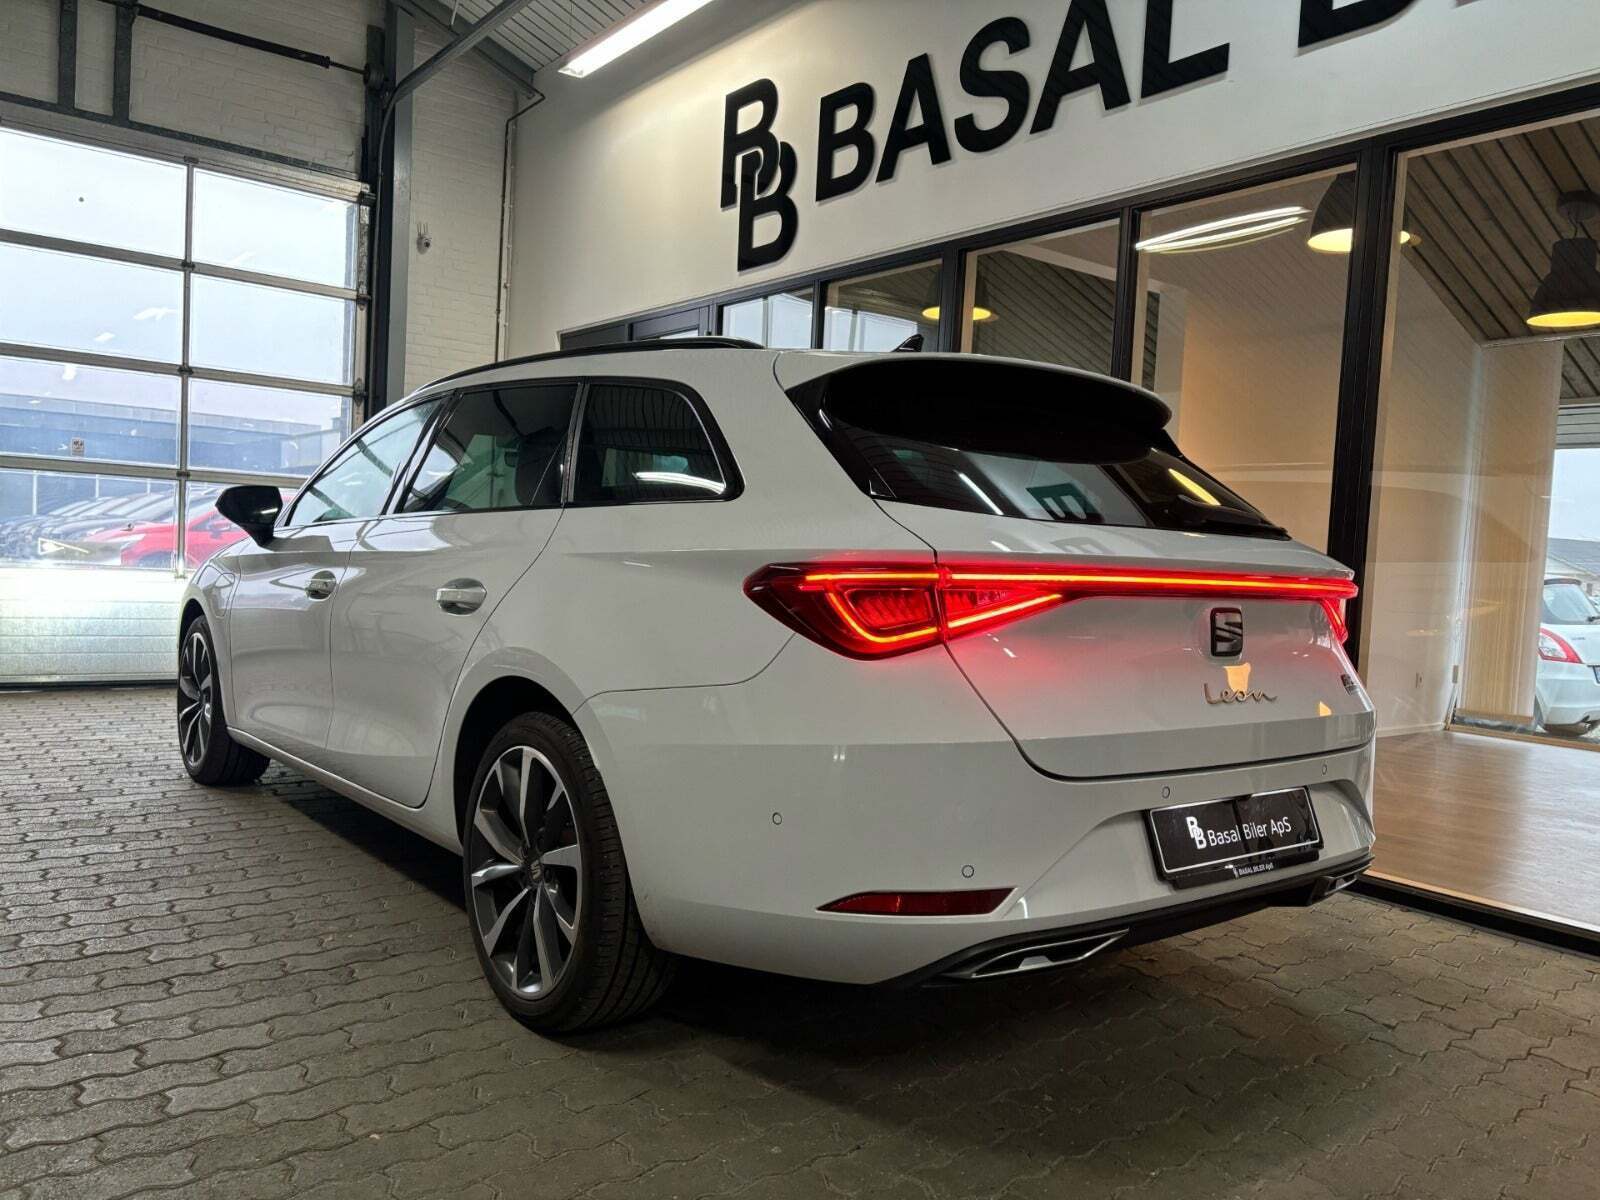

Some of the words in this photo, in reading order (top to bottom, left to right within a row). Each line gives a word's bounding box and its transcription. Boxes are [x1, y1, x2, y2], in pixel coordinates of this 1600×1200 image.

[815, 0, 1229, 202] BASAL
[1208, 825, 1241, 846] Basal
[1243, 822, 1268, 840] Biler
[1271, 816, 1291, 837] ApS
